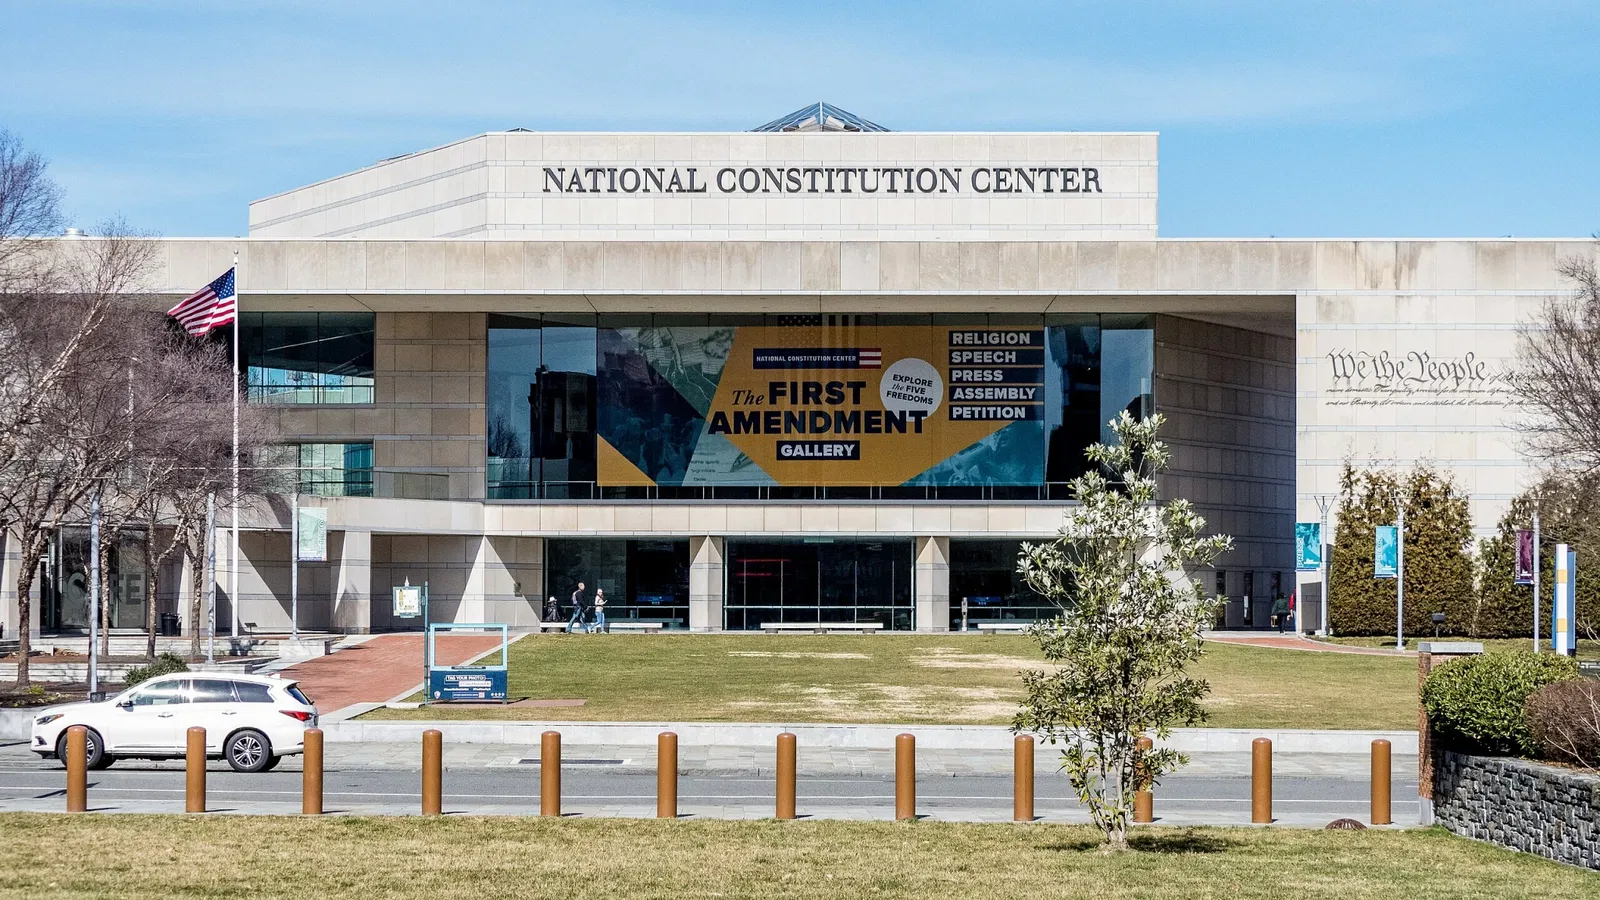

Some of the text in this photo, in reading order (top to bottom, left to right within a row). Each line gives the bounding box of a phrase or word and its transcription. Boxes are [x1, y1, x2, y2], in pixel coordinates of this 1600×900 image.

[543, 168, 1102, 193] NATIONAL CONSTITUTION CENTER
[952, 332, 1030, 345] RELIGION
[952, 351, 1016, 363] SPEECH
[1326, 348, 1372, 385] We
[1371, 350, 1411, 384] the
[1403, 349, 1490, 389] People
[892, 374, 933, 388] EXPLORE
[952, 370, 1003, 382] PRESS
[732, 381, 866, 405] The FIRST
[892, 382, 926, 395] the FIVE
[953, 388, 1035, 400] ASSEMBLY
[886, 390, 933, 405] FREEDOMS
[953, 406, 1026, 419] PETITION
[708, 410, 927, 434] AMENDMENT
[780, 444, 856, 457] GALLERY
